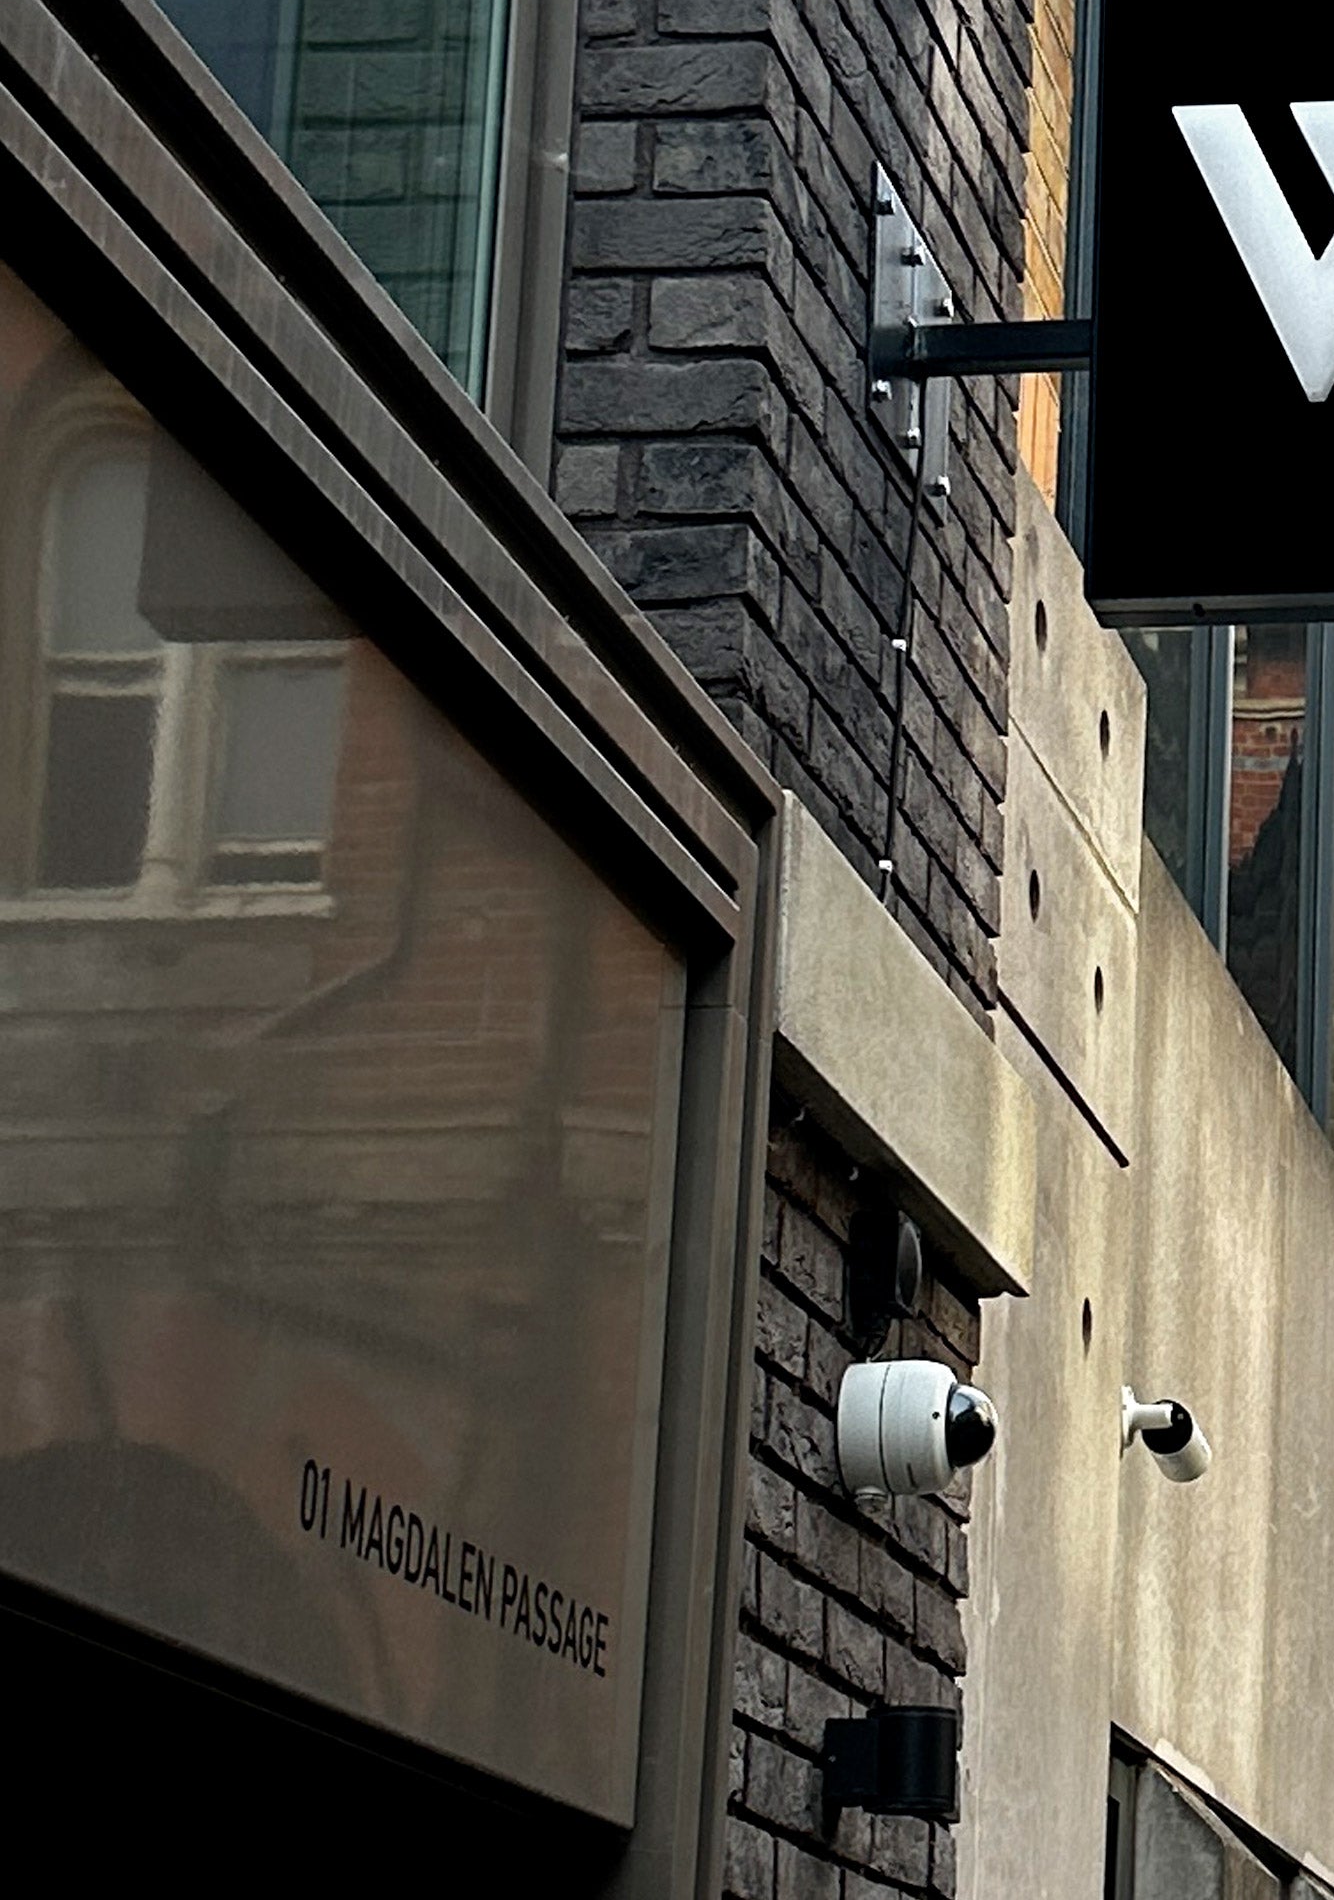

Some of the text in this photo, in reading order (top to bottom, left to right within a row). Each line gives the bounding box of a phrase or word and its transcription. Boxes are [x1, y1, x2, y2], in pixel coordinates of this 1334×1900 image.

[301, 1458, 609, 1678] 01 MAGDALEN PASSAGE
